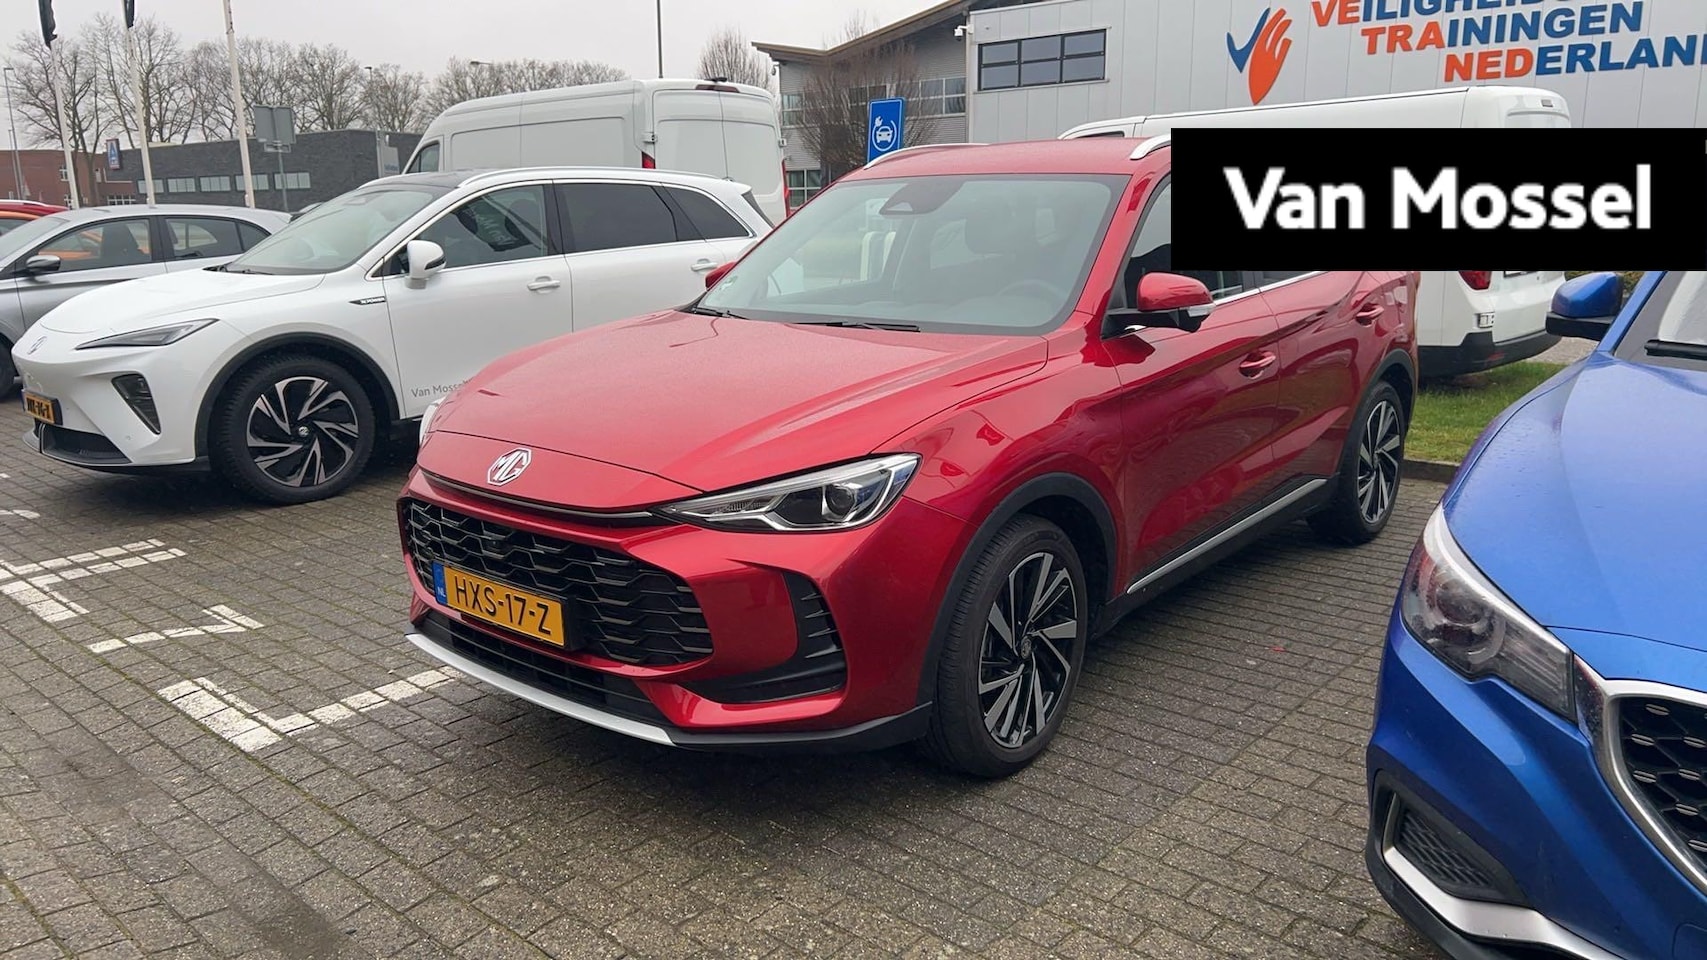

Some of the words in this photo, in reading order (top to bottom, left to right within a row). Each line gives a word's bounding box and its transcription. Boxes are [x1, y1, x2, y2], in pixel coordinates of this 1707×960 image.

[1361, 1, 1644, 55] TRAININGEN
[1444, 34, 1707, 82] NEDERLAN
[411, 388, 430, 397] Van
[491, 450, 529, 482] MG
[437, 585, 447, 598] NL
[454, 575, 552, 636] HXS-17-Z
